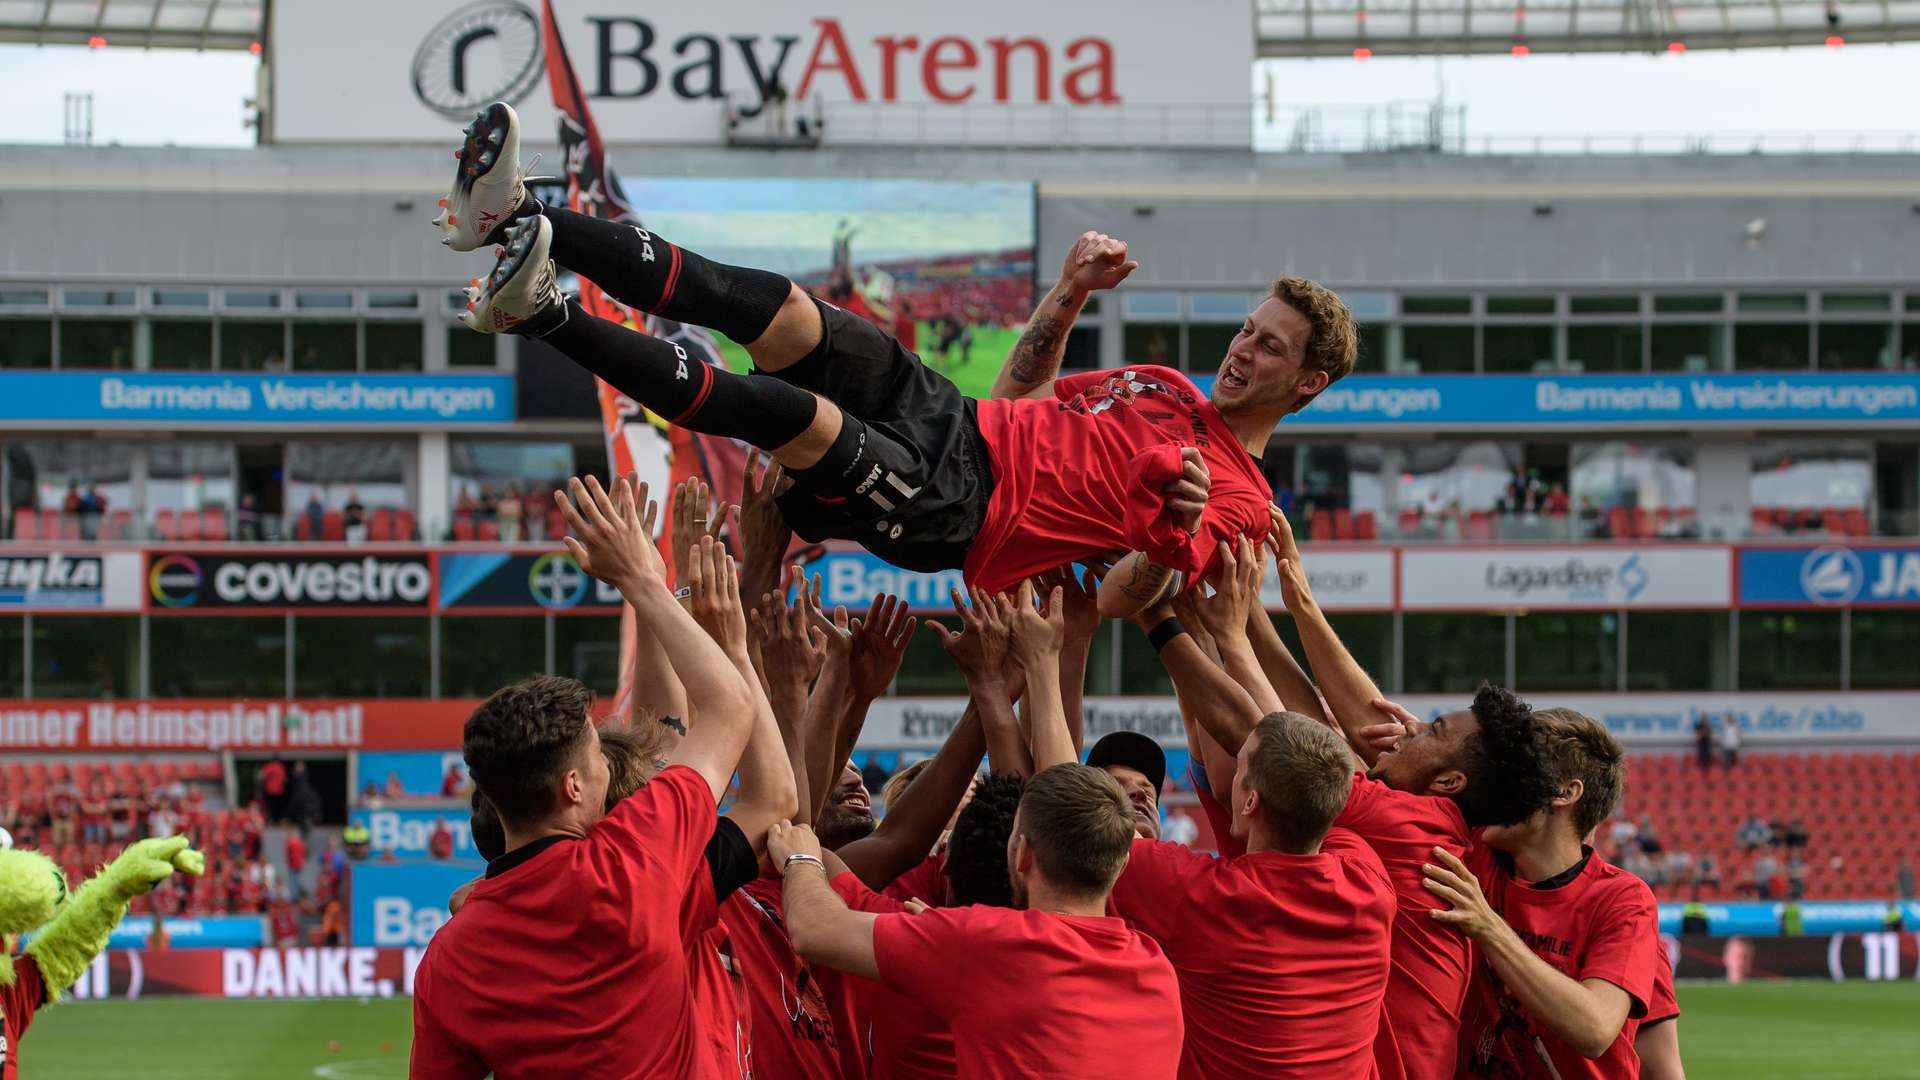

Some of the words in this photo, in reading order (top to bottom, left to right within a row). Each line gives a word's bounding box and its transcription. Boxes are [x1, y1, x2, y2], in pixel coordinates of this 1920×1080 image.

[586, 17, 1120, 116] BayArena
[101, 380, 251, 412] Barmenia
[260, 380, 496, 416] Versicherungen
[1312, 388, 1441, 418] erungen
[1536, 383, 1682, 412] Barmenia
[1692, 380, 1918, 416] Versicherungen
[855, 463, 883, 494] JAKO
[214, 562, 430, 600] covestro
[88, 703, 282, 750] Heimspiel
[222, 948, 394, 997] DANKE,
